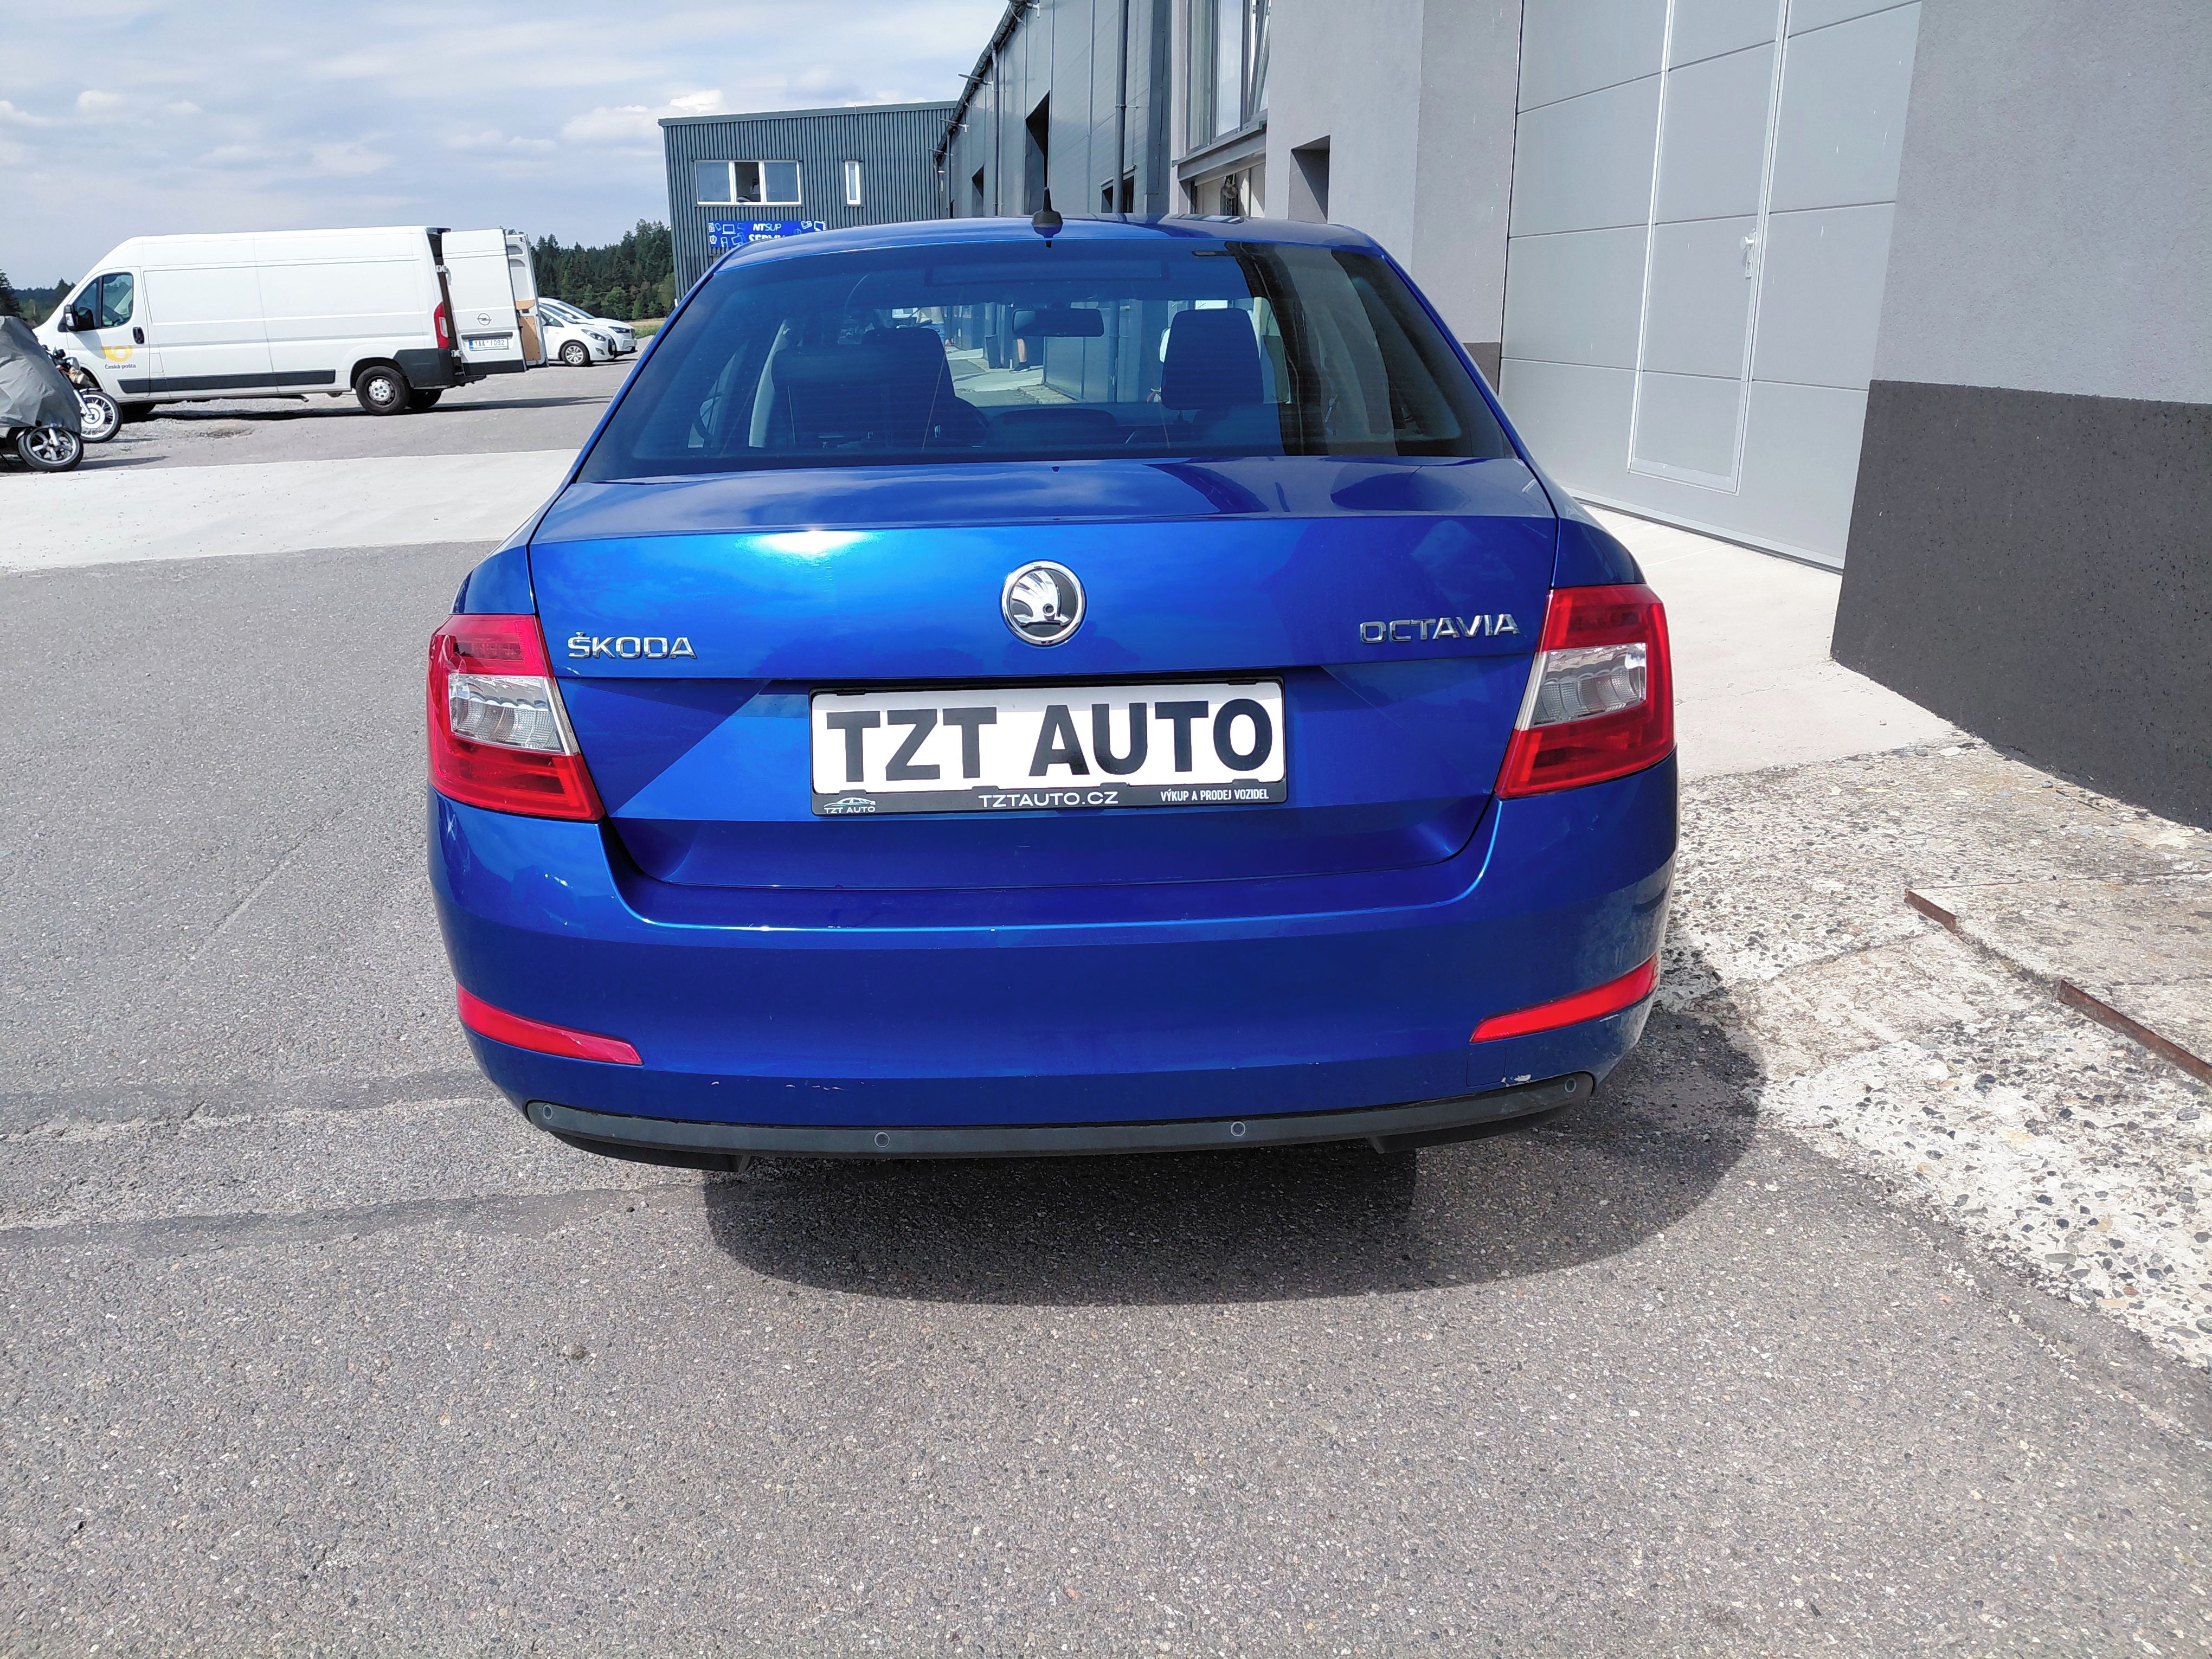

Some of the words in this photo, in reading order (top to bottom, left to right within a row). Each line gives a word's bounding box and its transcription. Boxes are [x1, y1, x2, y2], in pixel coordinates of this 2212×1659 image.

[753, 223, 782, 232] NTSUP
[1359, 613, 1521, 644] OCTAVIA
[567, 631, 698, 660] ŠKODA
[826, 706, 998, 783] TZT
[1028, 698, 1273, 777] AUTO
[978, 790, 1119, 808] TZTAUTO.CZ
[1160, 788, 1189, 802] VÝKUP
[1191, 790, 1198, 801] A
[1200, 789, 1232, 801] PRODEJ
[1233, 788, 1270, 800] VOZIDEL
